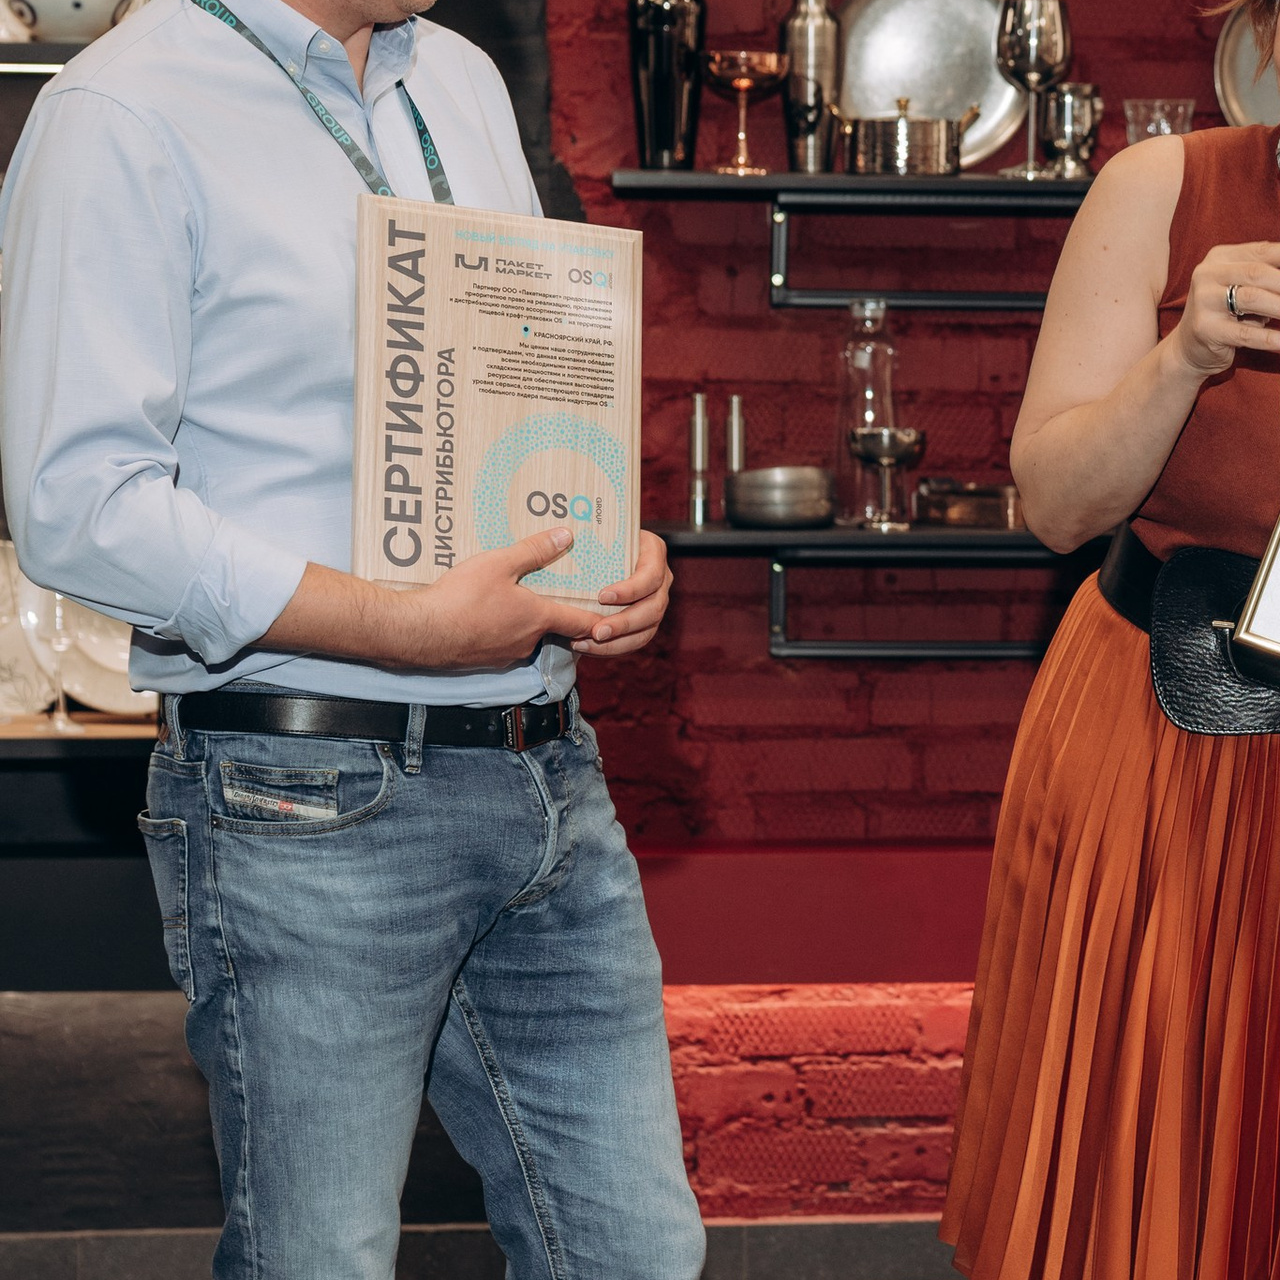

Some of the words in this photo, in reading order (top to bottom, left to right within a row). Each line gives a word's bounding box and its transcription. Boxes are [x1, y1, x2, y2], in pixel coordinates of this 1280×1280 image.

[306, 92, 351, 146] GROUP
[421, 133, 438, 169] OSQ
[455, 229, 495, 243] НОВЫЙ
[495, 258, 543, 270] ПАКЕТ
[495, 266, 552, 280] МАРКЕТ
[472, 282, 500, 292] Партнеру
[568, 268, 607, 289] OSQ
[464, 290, 506, 301] приоритетное
[478, 307, 504, 316] пищевой
[506, 311, 552, 323] крафт-упаковки
[500, 303, 524, 311] полного
[525, 306, 566, 316] ассортимента
[533, 330, 583, 343] КРАСНОЯРСКИЙ
[585, 336, 601, 345] КРАЙ,
[603, 338, 613, 346] РФ.
[477, 346, 523, 356] подтверждаем,
[558, 355, 586, 364] компания
[587, 358, 614, 367] обладает
[567, 348, 614, 359] сотрудничество
[485, 363, 521, 372] складскими
[522, 367, 560, 377] мощностями
[566, 373, 614, 383] логистическими
[520, 358, 565, 369] необходимыми
[567, 365, 614, 375] компетенциями,
[471, 378, 493, 386] уровня
[495, 381, 522, 389] сервиса,
[523, 384, 579, 396] соответствующего
[580, 391, 614, 400] стандартам
[487, 372, 521, 381] ресурсами
[533, 376, 573, 387] обеспечения
[574, 381, 614, 391] высочайшего
[383, 219, 426, 567] СЕРТИФИКАТ
[478, 386, 515, 396] глобального
[539, 393, 565, 402] пищевой
[567, 397, 598, 407] индустрии
[434, 348, 456, 569] ДИСТРИБЬЮТОРА
[527, 491, 593, 523] OSQ
